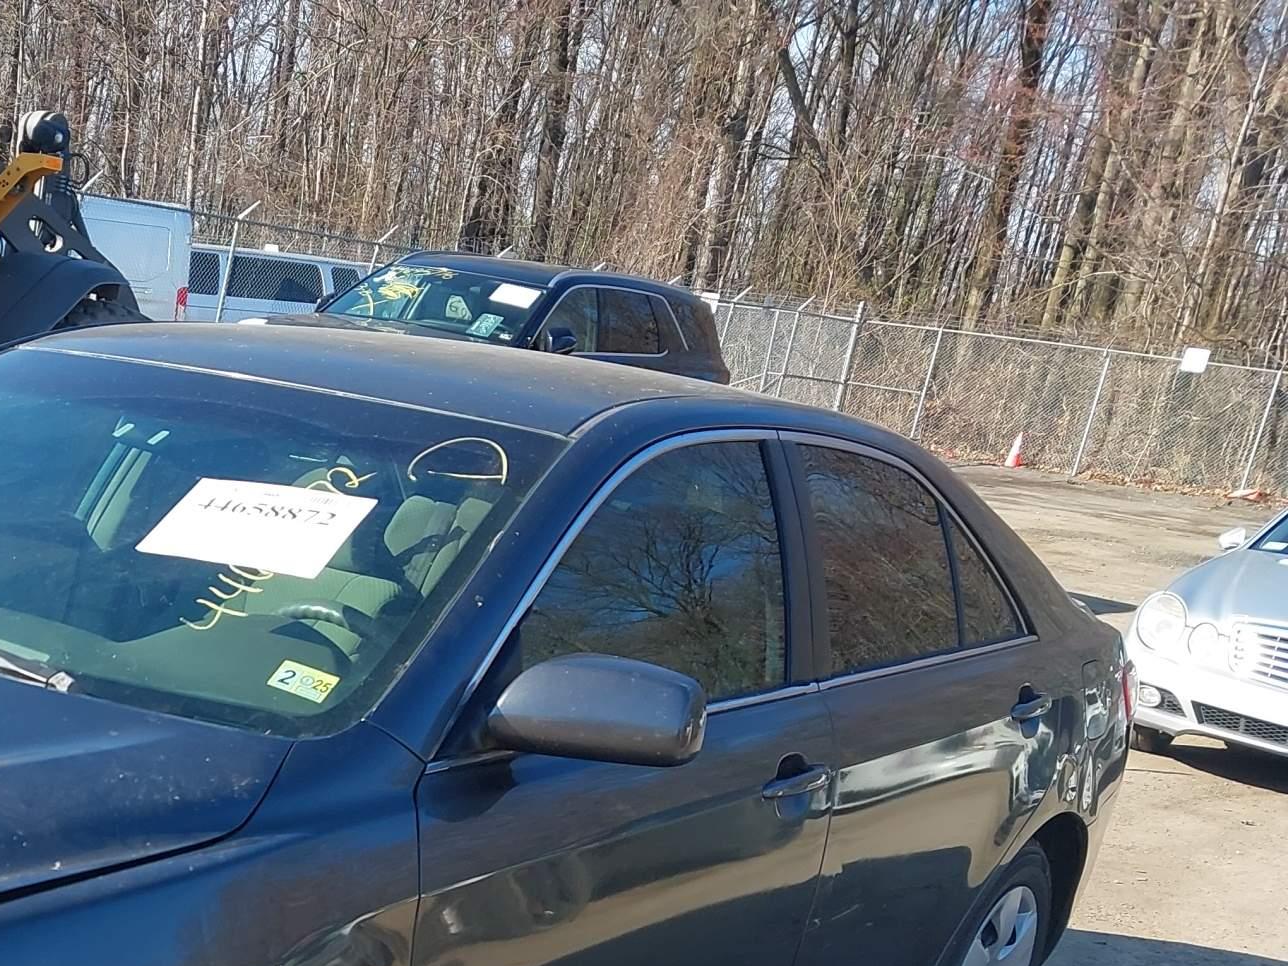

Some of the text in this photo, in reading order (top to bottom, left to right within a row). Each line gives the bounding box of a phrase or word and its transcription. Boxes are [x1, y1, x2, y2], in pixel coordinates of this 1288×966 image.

[197, 497, 337, 526] 44658872
[277, 669, 297, 686] 2
[312, 679, 333, 693] 25
